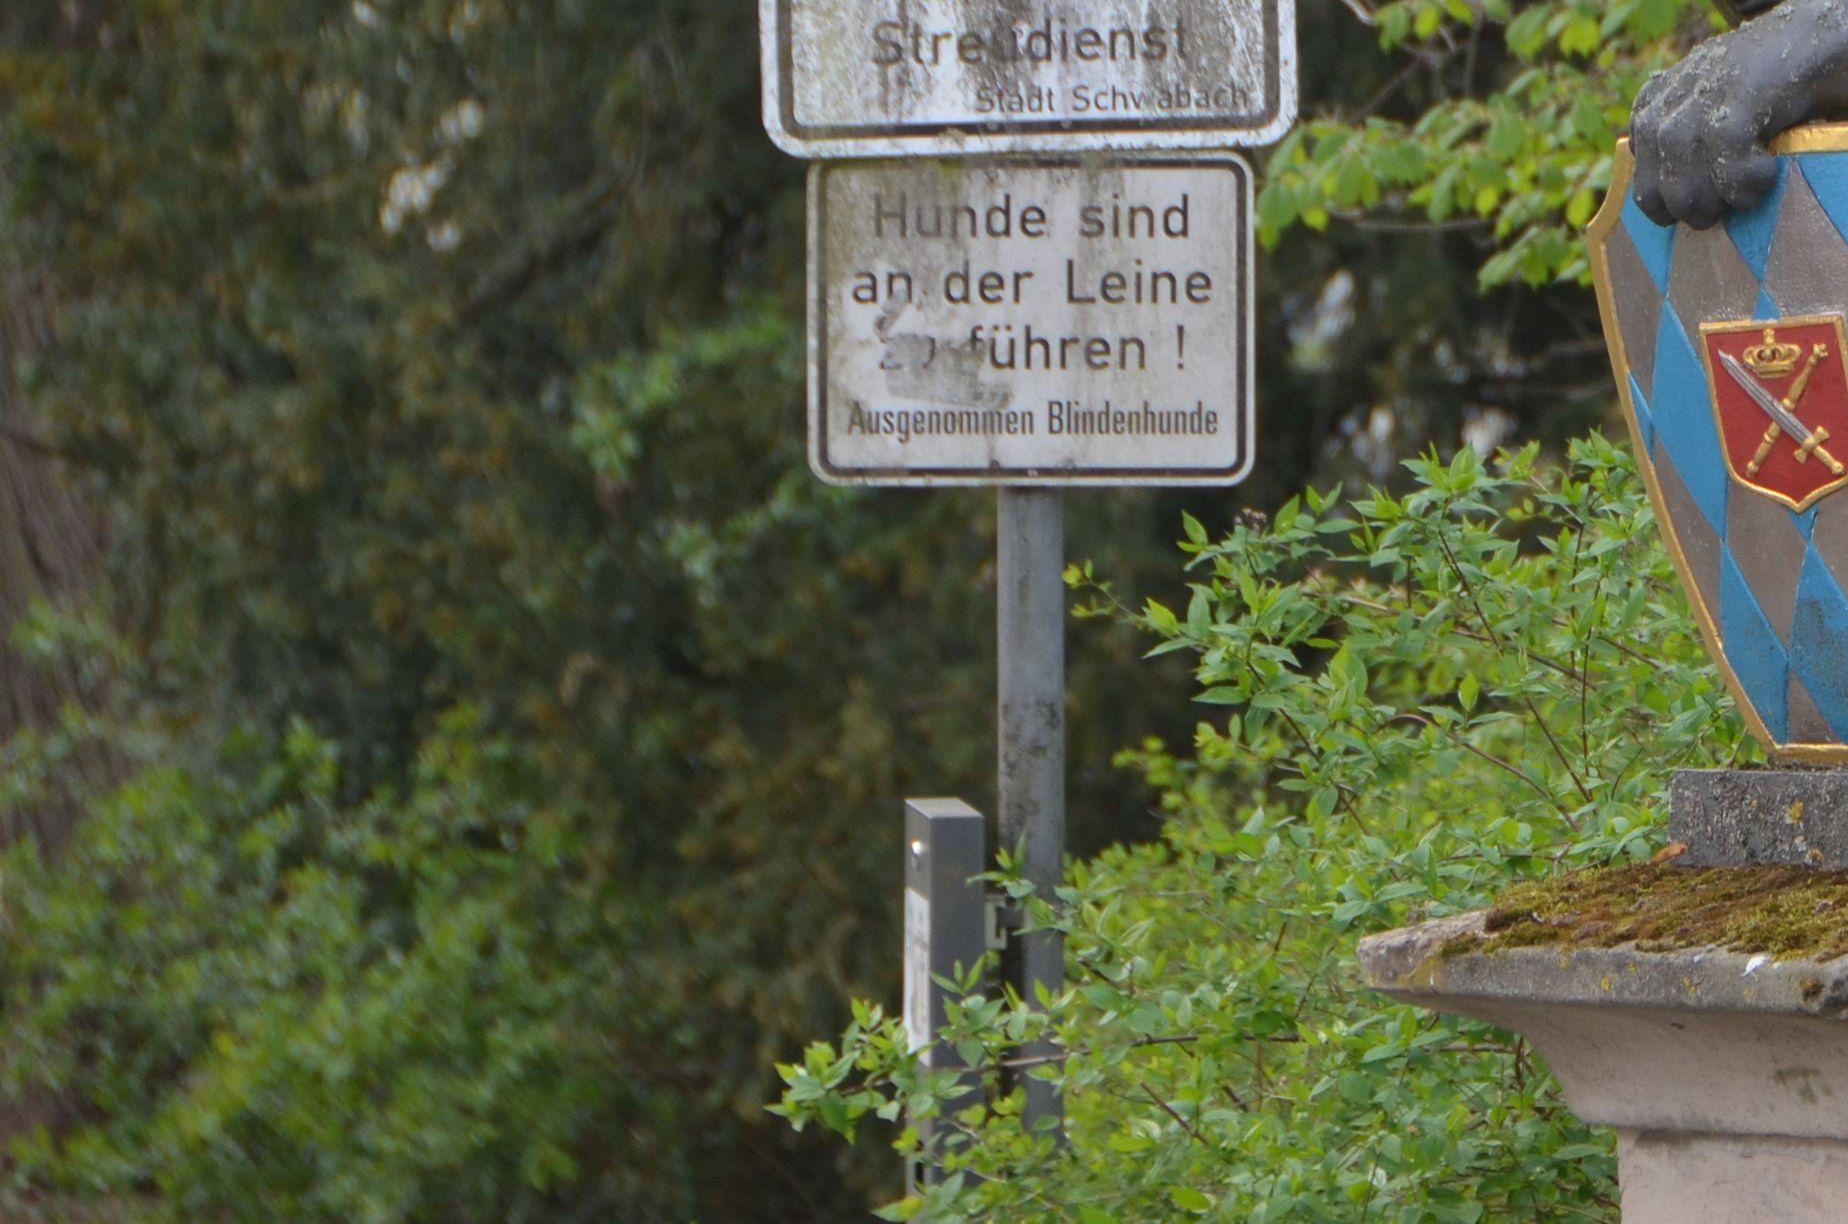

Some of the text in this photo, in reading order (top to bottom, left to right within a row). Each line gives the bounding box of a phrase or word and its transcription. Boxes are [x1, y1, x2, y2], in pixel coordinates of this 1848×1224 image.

[976, 85, 1055, 114] Stadt
[873, 192, 1190, 239] Hunde sind
[851, 259, 1213, 305] an der Leine
[970, 324, 1147, 371] führen
[847, 399, 1219, 443] Ausgenommen Blindenhunde
